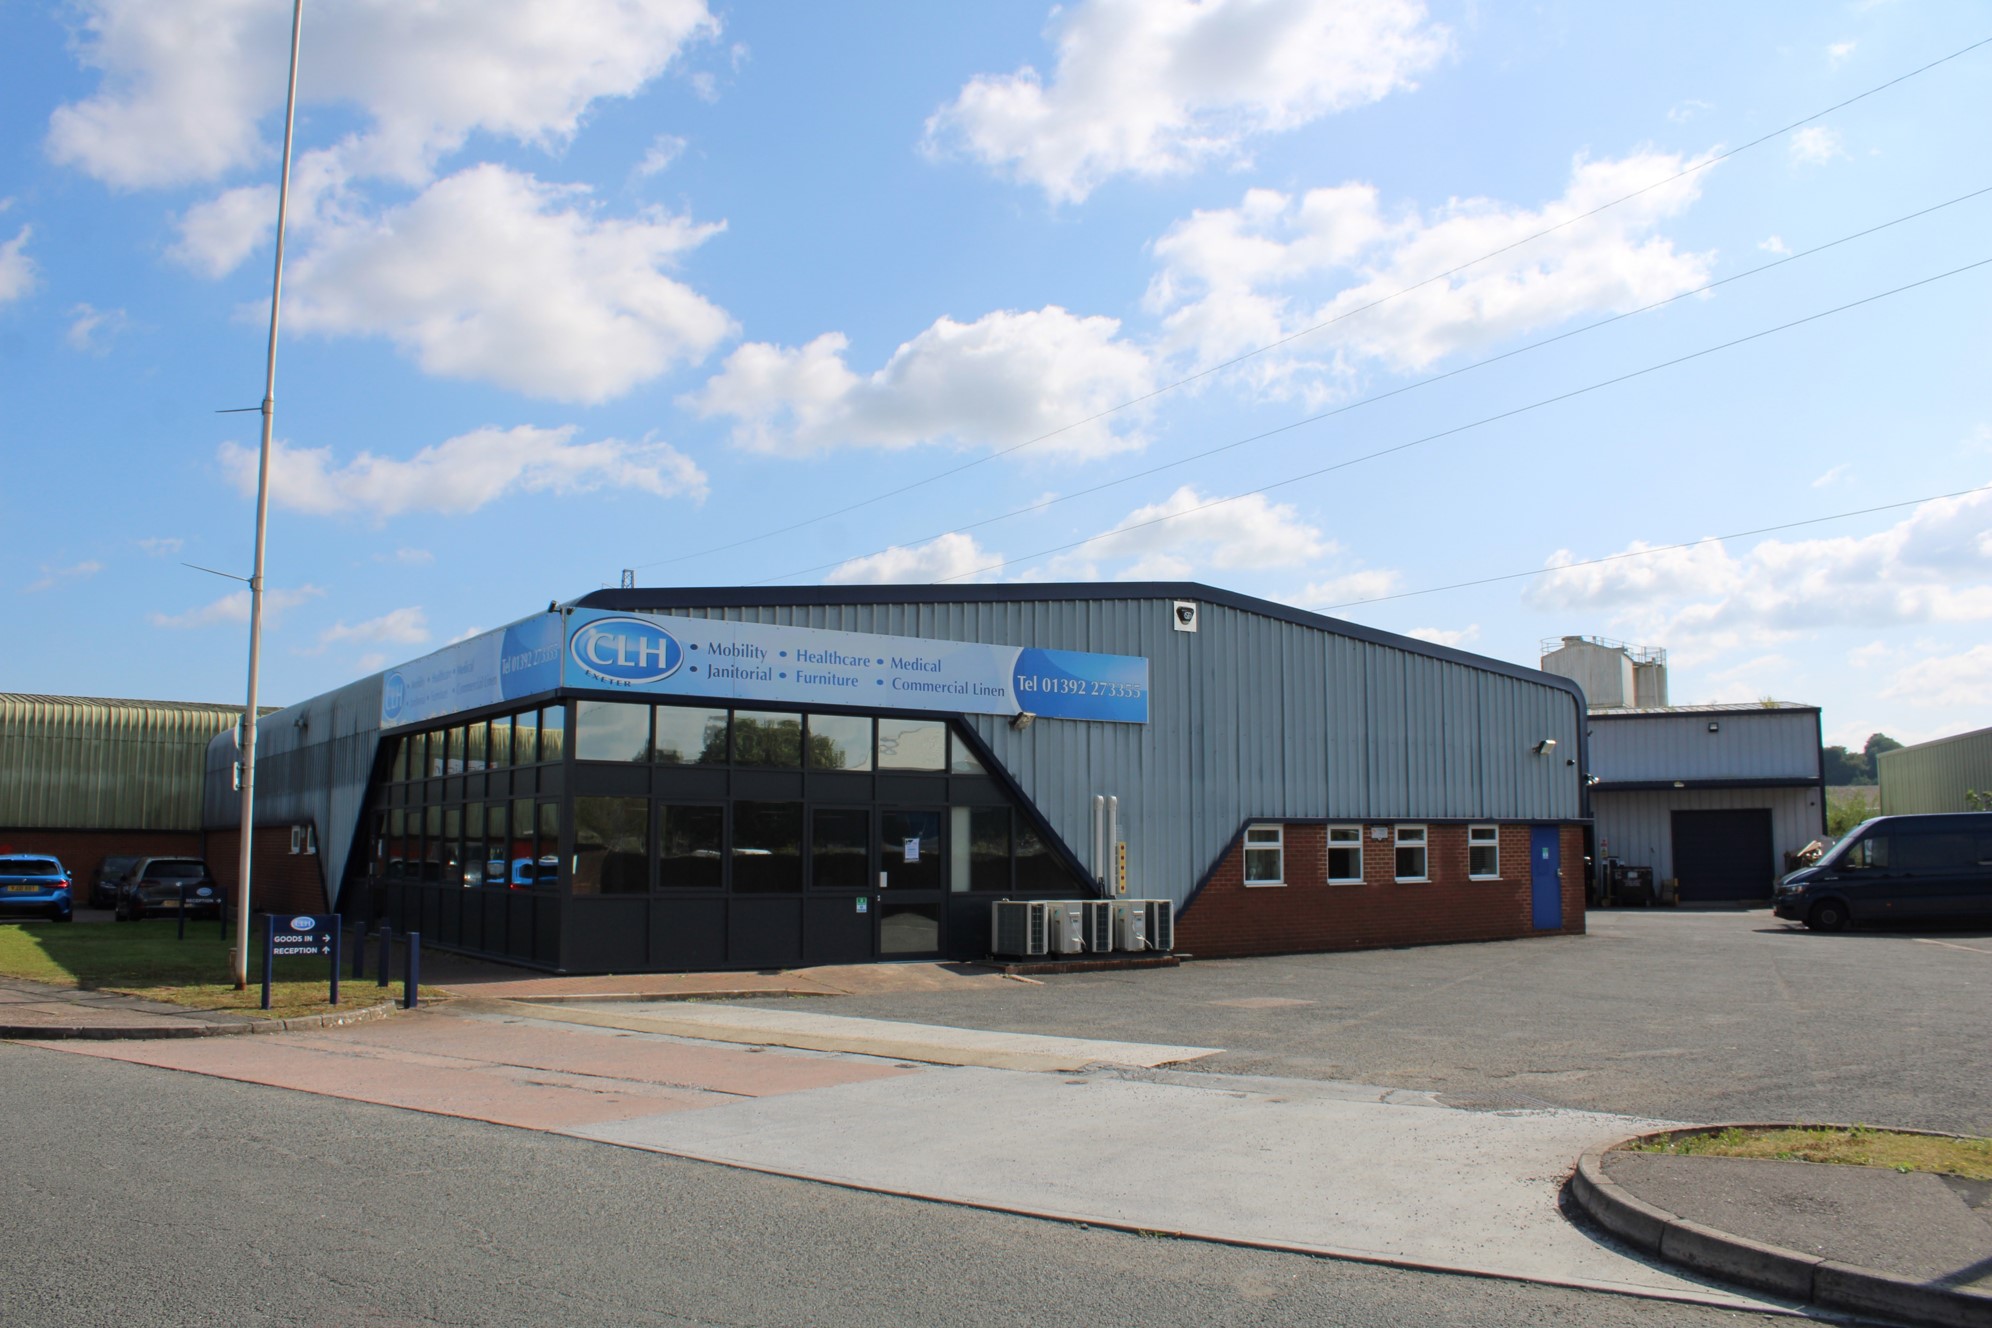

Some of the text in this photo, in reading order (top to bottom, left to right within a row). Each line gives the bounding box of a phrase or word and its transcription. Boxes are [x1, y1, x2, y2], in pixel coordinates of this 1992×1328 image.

[586, 632, 667, 669] CLH
[708, 642, 942, 673] Mobility Healthcare Medical
[585, 669, 632, 687] EXETER
[707, 663, 1006, 697] Janitorial Furniture Commercial Linen
[1017, 675, 1141, 699] Tel 01392 273355
